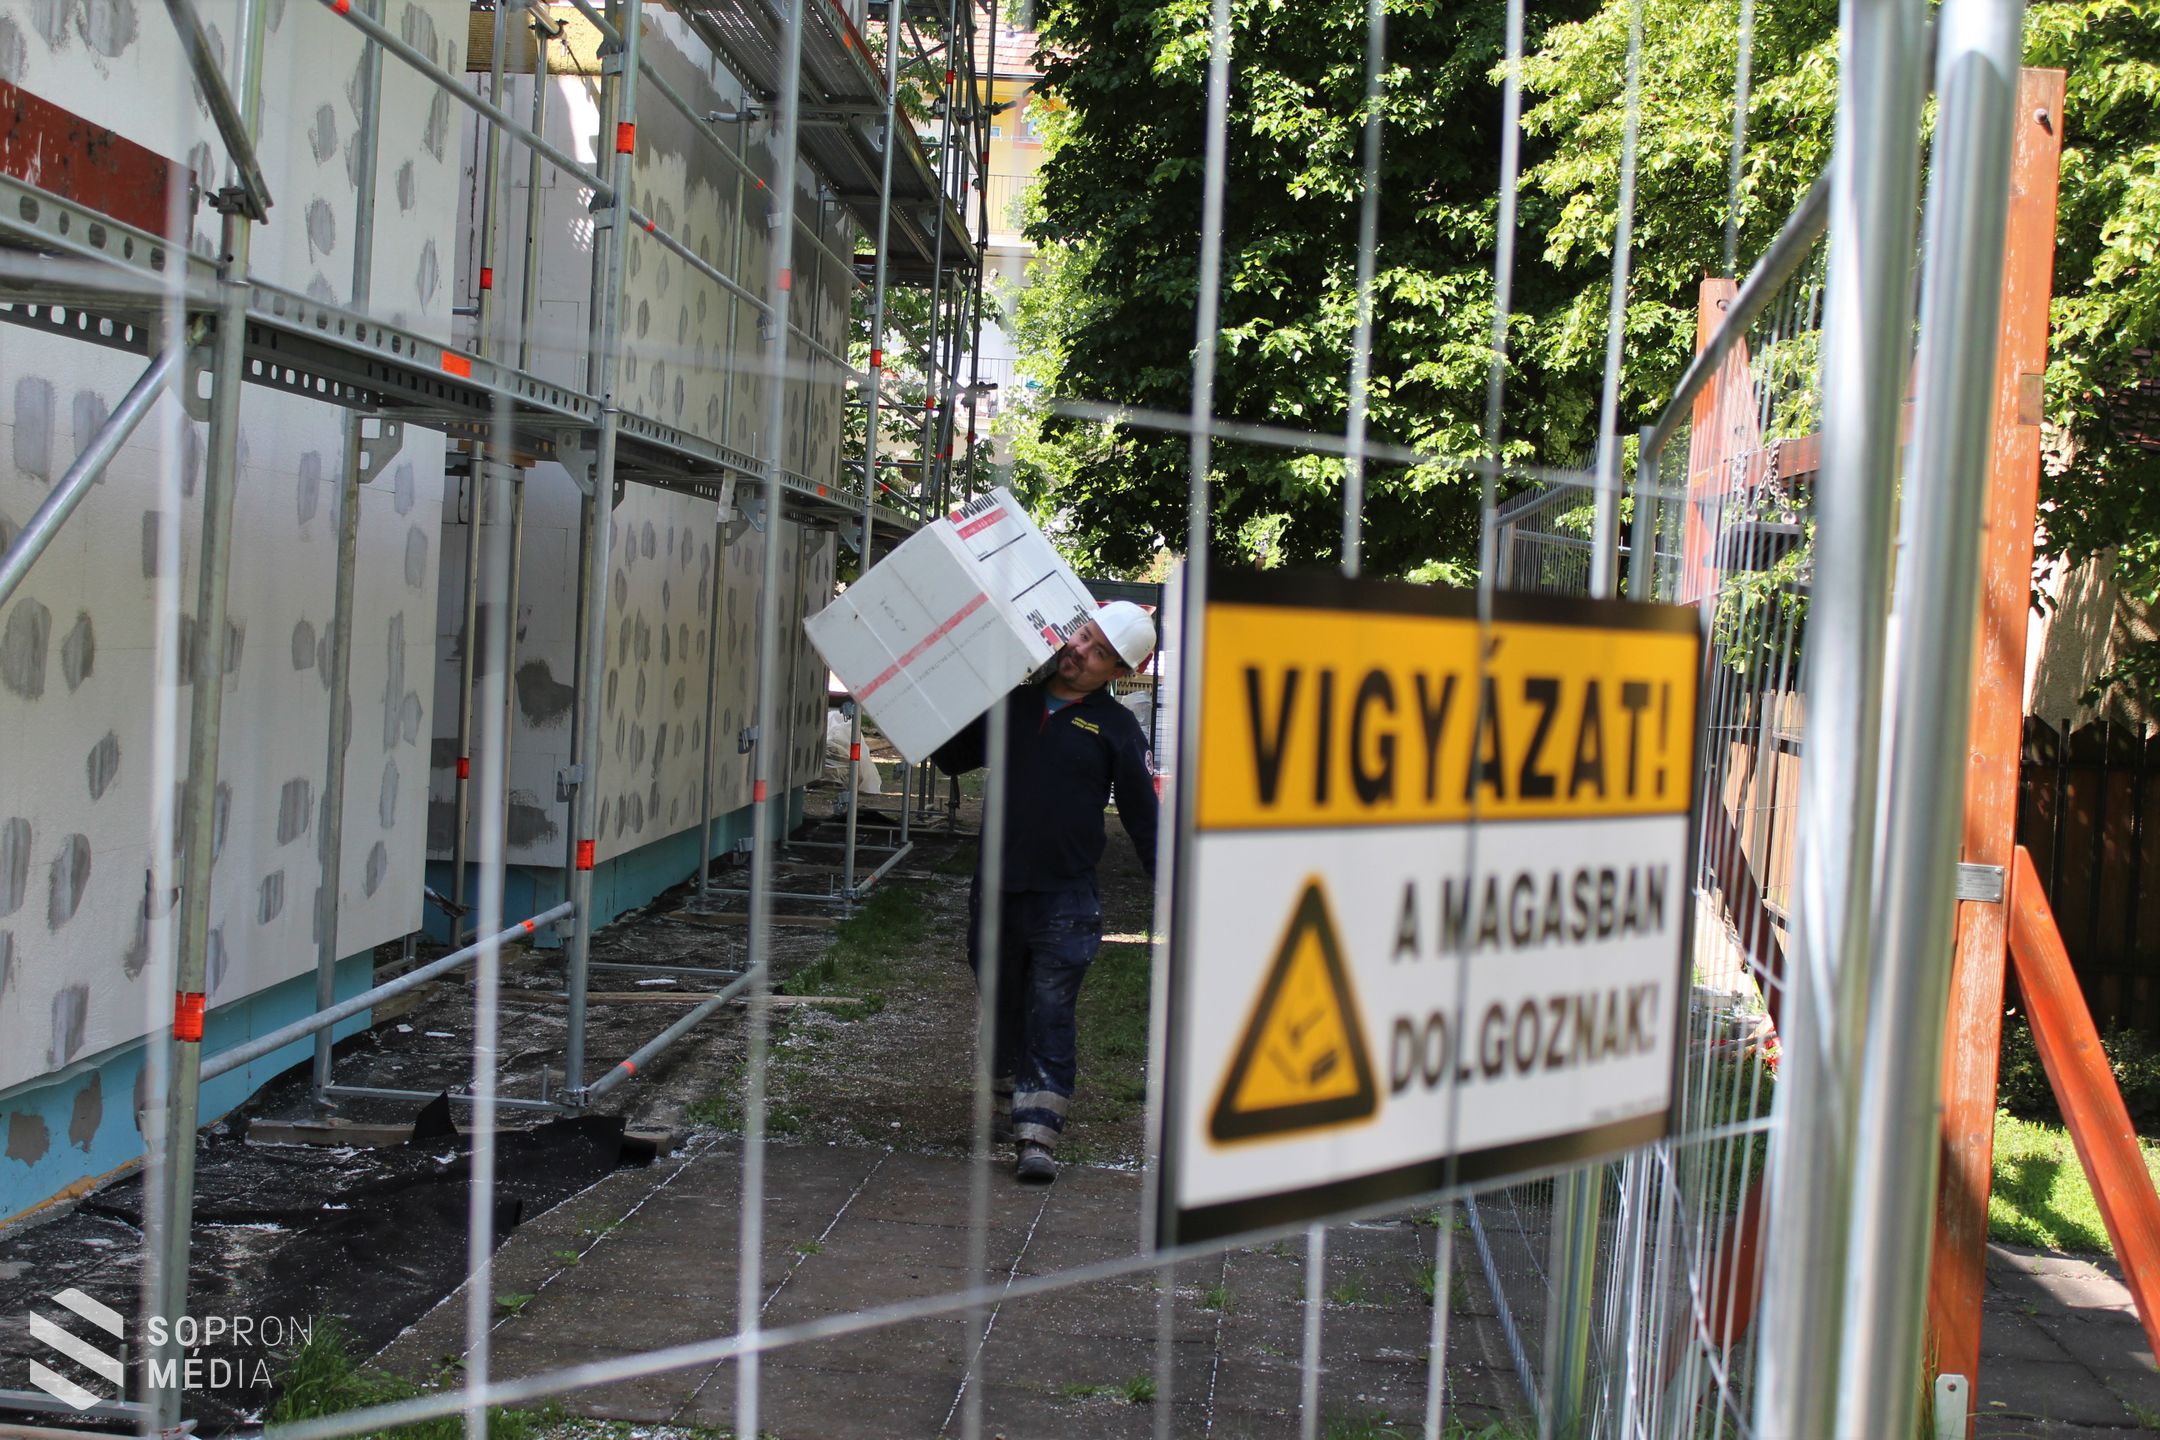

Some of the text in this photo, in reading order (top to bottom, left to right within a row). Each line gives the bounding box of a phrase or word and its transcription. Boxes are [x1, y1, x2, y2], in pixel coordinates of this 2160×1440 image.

[1241, 635, 1670, 808] VIGYÁZAT!
[1391, 863, 1669, 963] A MAGASBAN
[1389, 981, 1660, 1097] DOLGOZNAK!
